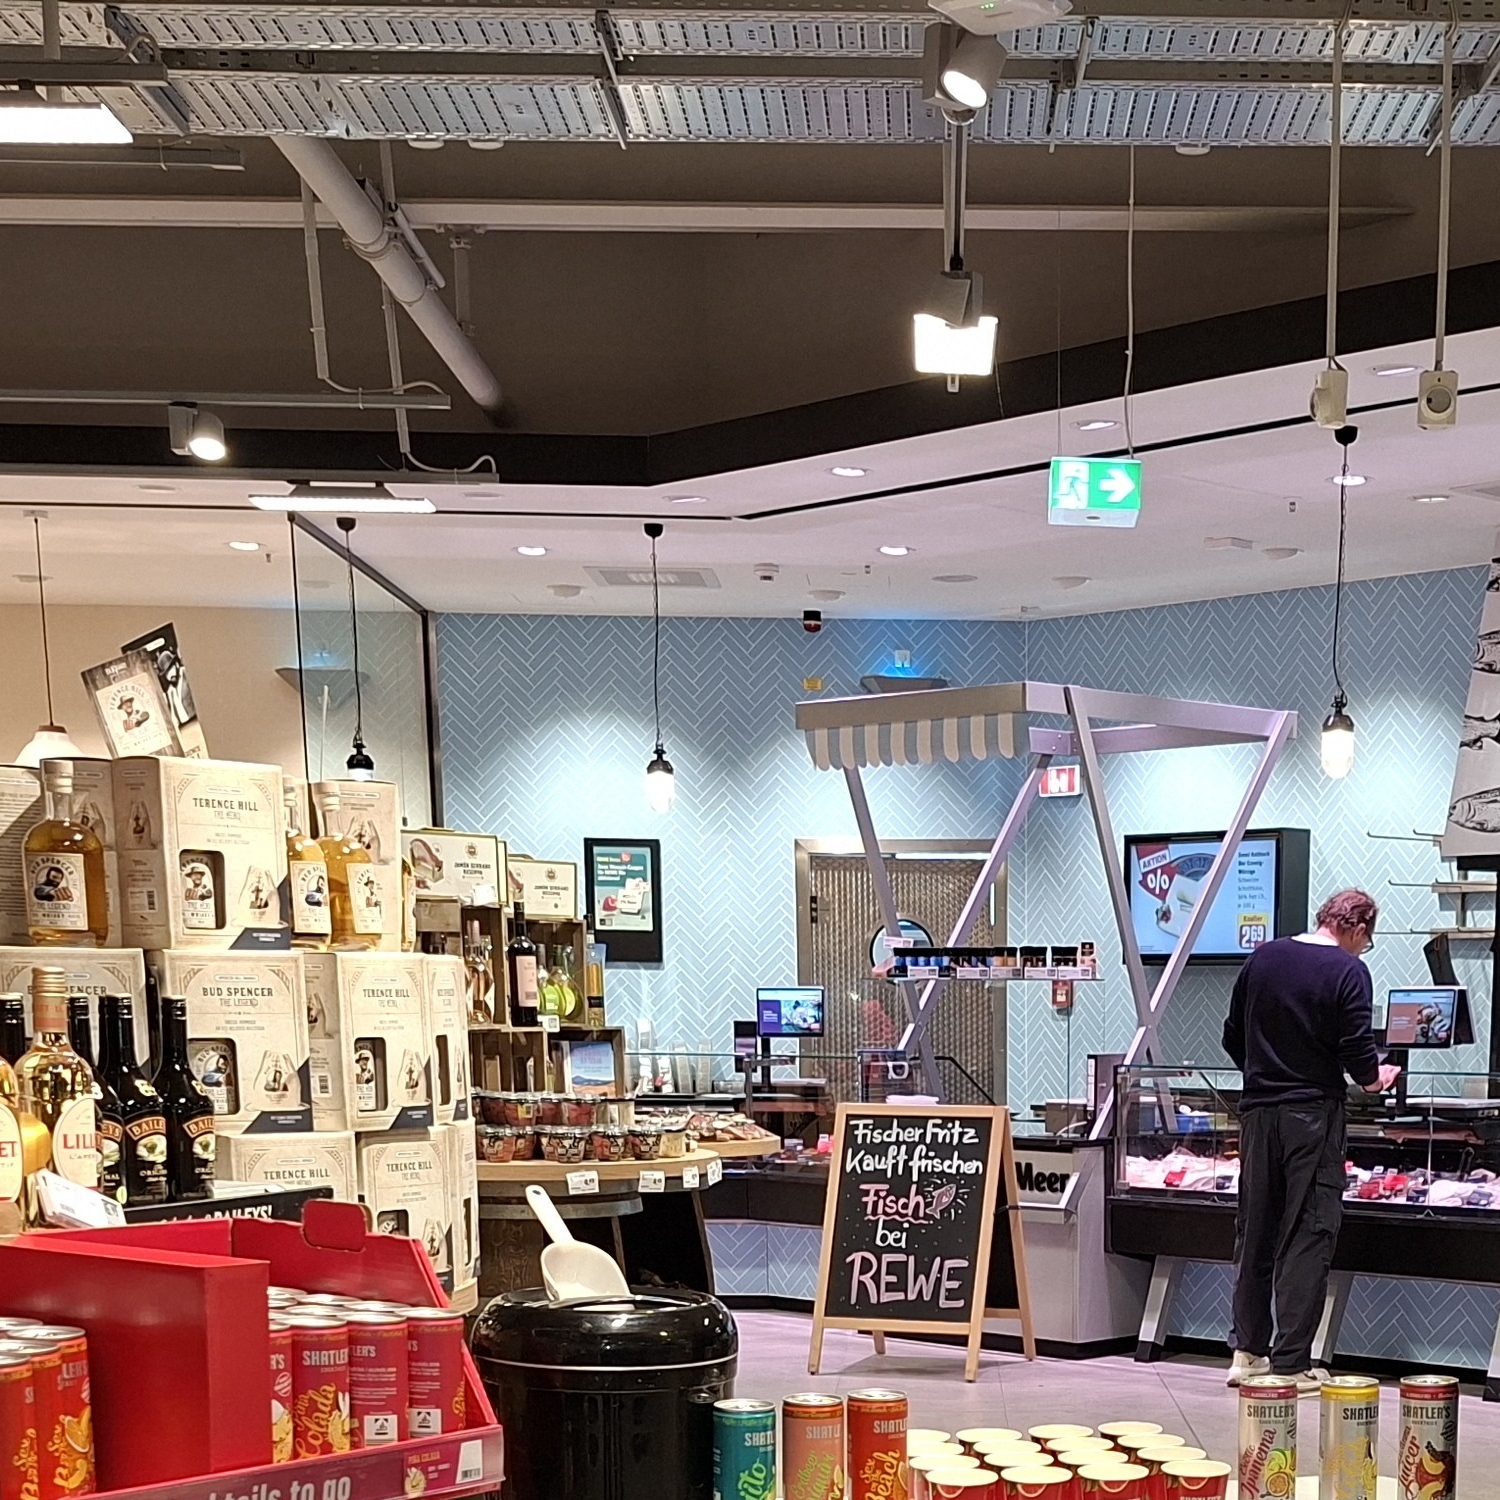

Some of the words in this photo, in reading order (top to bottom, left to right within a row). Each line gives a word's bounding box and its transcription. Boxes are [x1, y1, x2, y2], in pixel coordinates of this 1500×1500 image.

[193, 798, 235, 810] TERENCE
[237, 799, 259, 811] HILL
[1141, 854, 1168, 869] AKTION
[64, 985, 107, 995] PENCER
[202, 987, 223, 997] BUD
[226, 987, 274, 997] SPENCER
[363, 988, 392, 998] TERENCE
[394, 988, 410, 998] HILL
[131, 1117, 166, 1136] BAILE
[188, 1117, 215, 1134] BAIL
[62, 1133, 97, 1150] LILL
[386, 1162, 416, 1172] TERENCE
[417, 1161, 433, 1170] HILL
[845, 1144, 908, 1179] Kauft
[909, 1145, 983, 1181] frischen
[263, 1169, 307, 1180] TERENCE
[309, 1168, 330, 1178] HILL
[1015, 1162, 1069, 1193] Meer
[859, 1183, 926, 1217] Fisch
[875, 1222, 909, 1249] bei
[845, 1251, 970, 1308] REWE
[302, 1348, 348, 1366] SHATLE
[1246, 1404, 1295, 1418] SHATLER'S
[1342, 1407, 1379, 1421] SHATLE
[1402, 1404, 1451, 1418] SHATLER'S
[805, 1424, 841, 1440] SHATL
[873, 1418, 908, 1434] SHATL
[744, 1430, 774, 1447] SHATL
